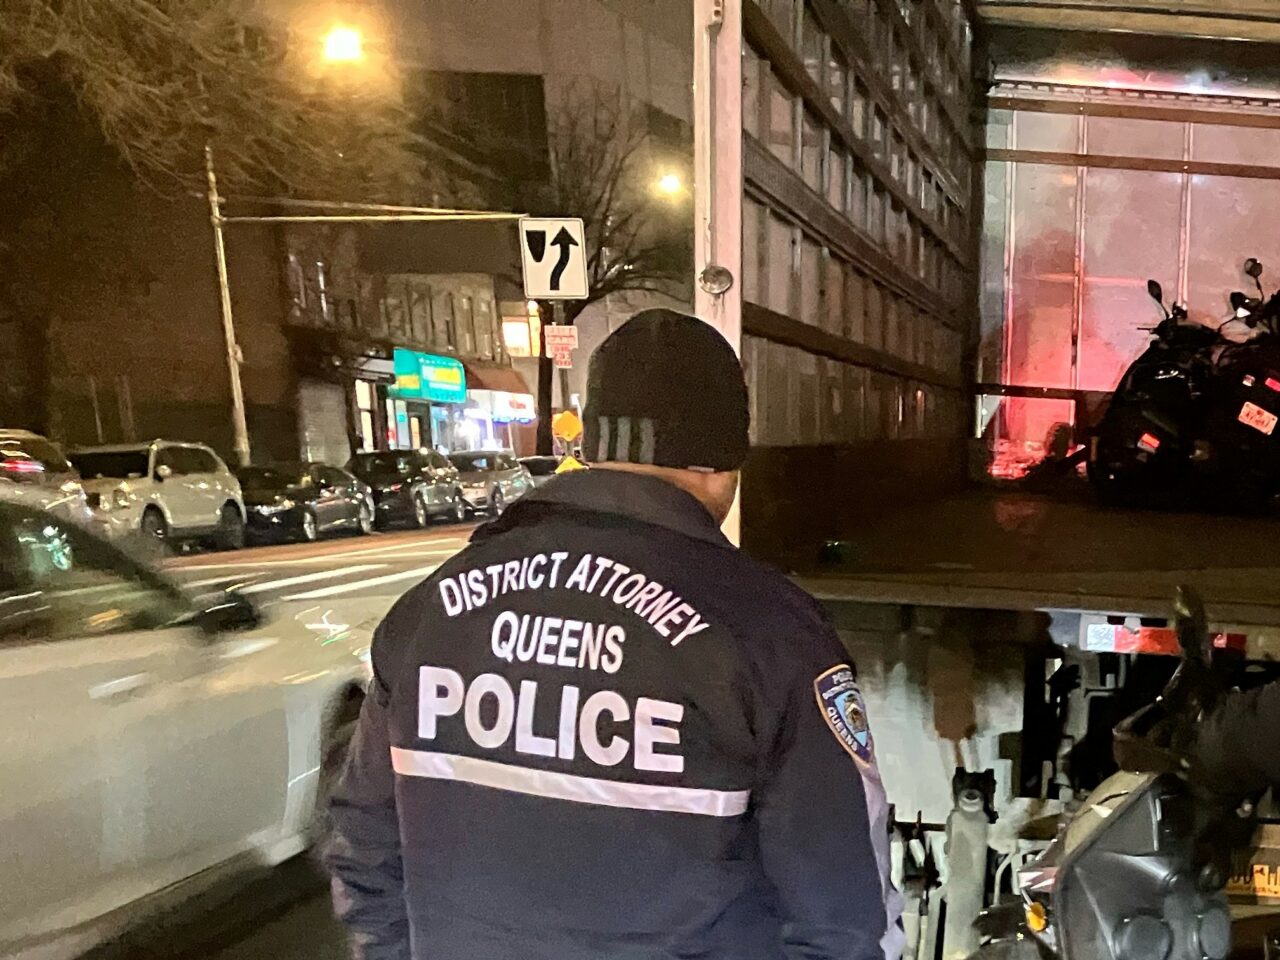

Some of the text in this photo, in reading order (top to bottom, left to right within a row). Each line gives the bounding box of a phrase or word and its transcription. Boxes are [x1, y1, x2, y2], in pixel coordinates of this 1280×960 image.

[438, 551, 710, 647] DISTRICT ATTORNEY
[491, 610, 626, 674] QUEENS
[417, 666, 684, 773] POLICE
